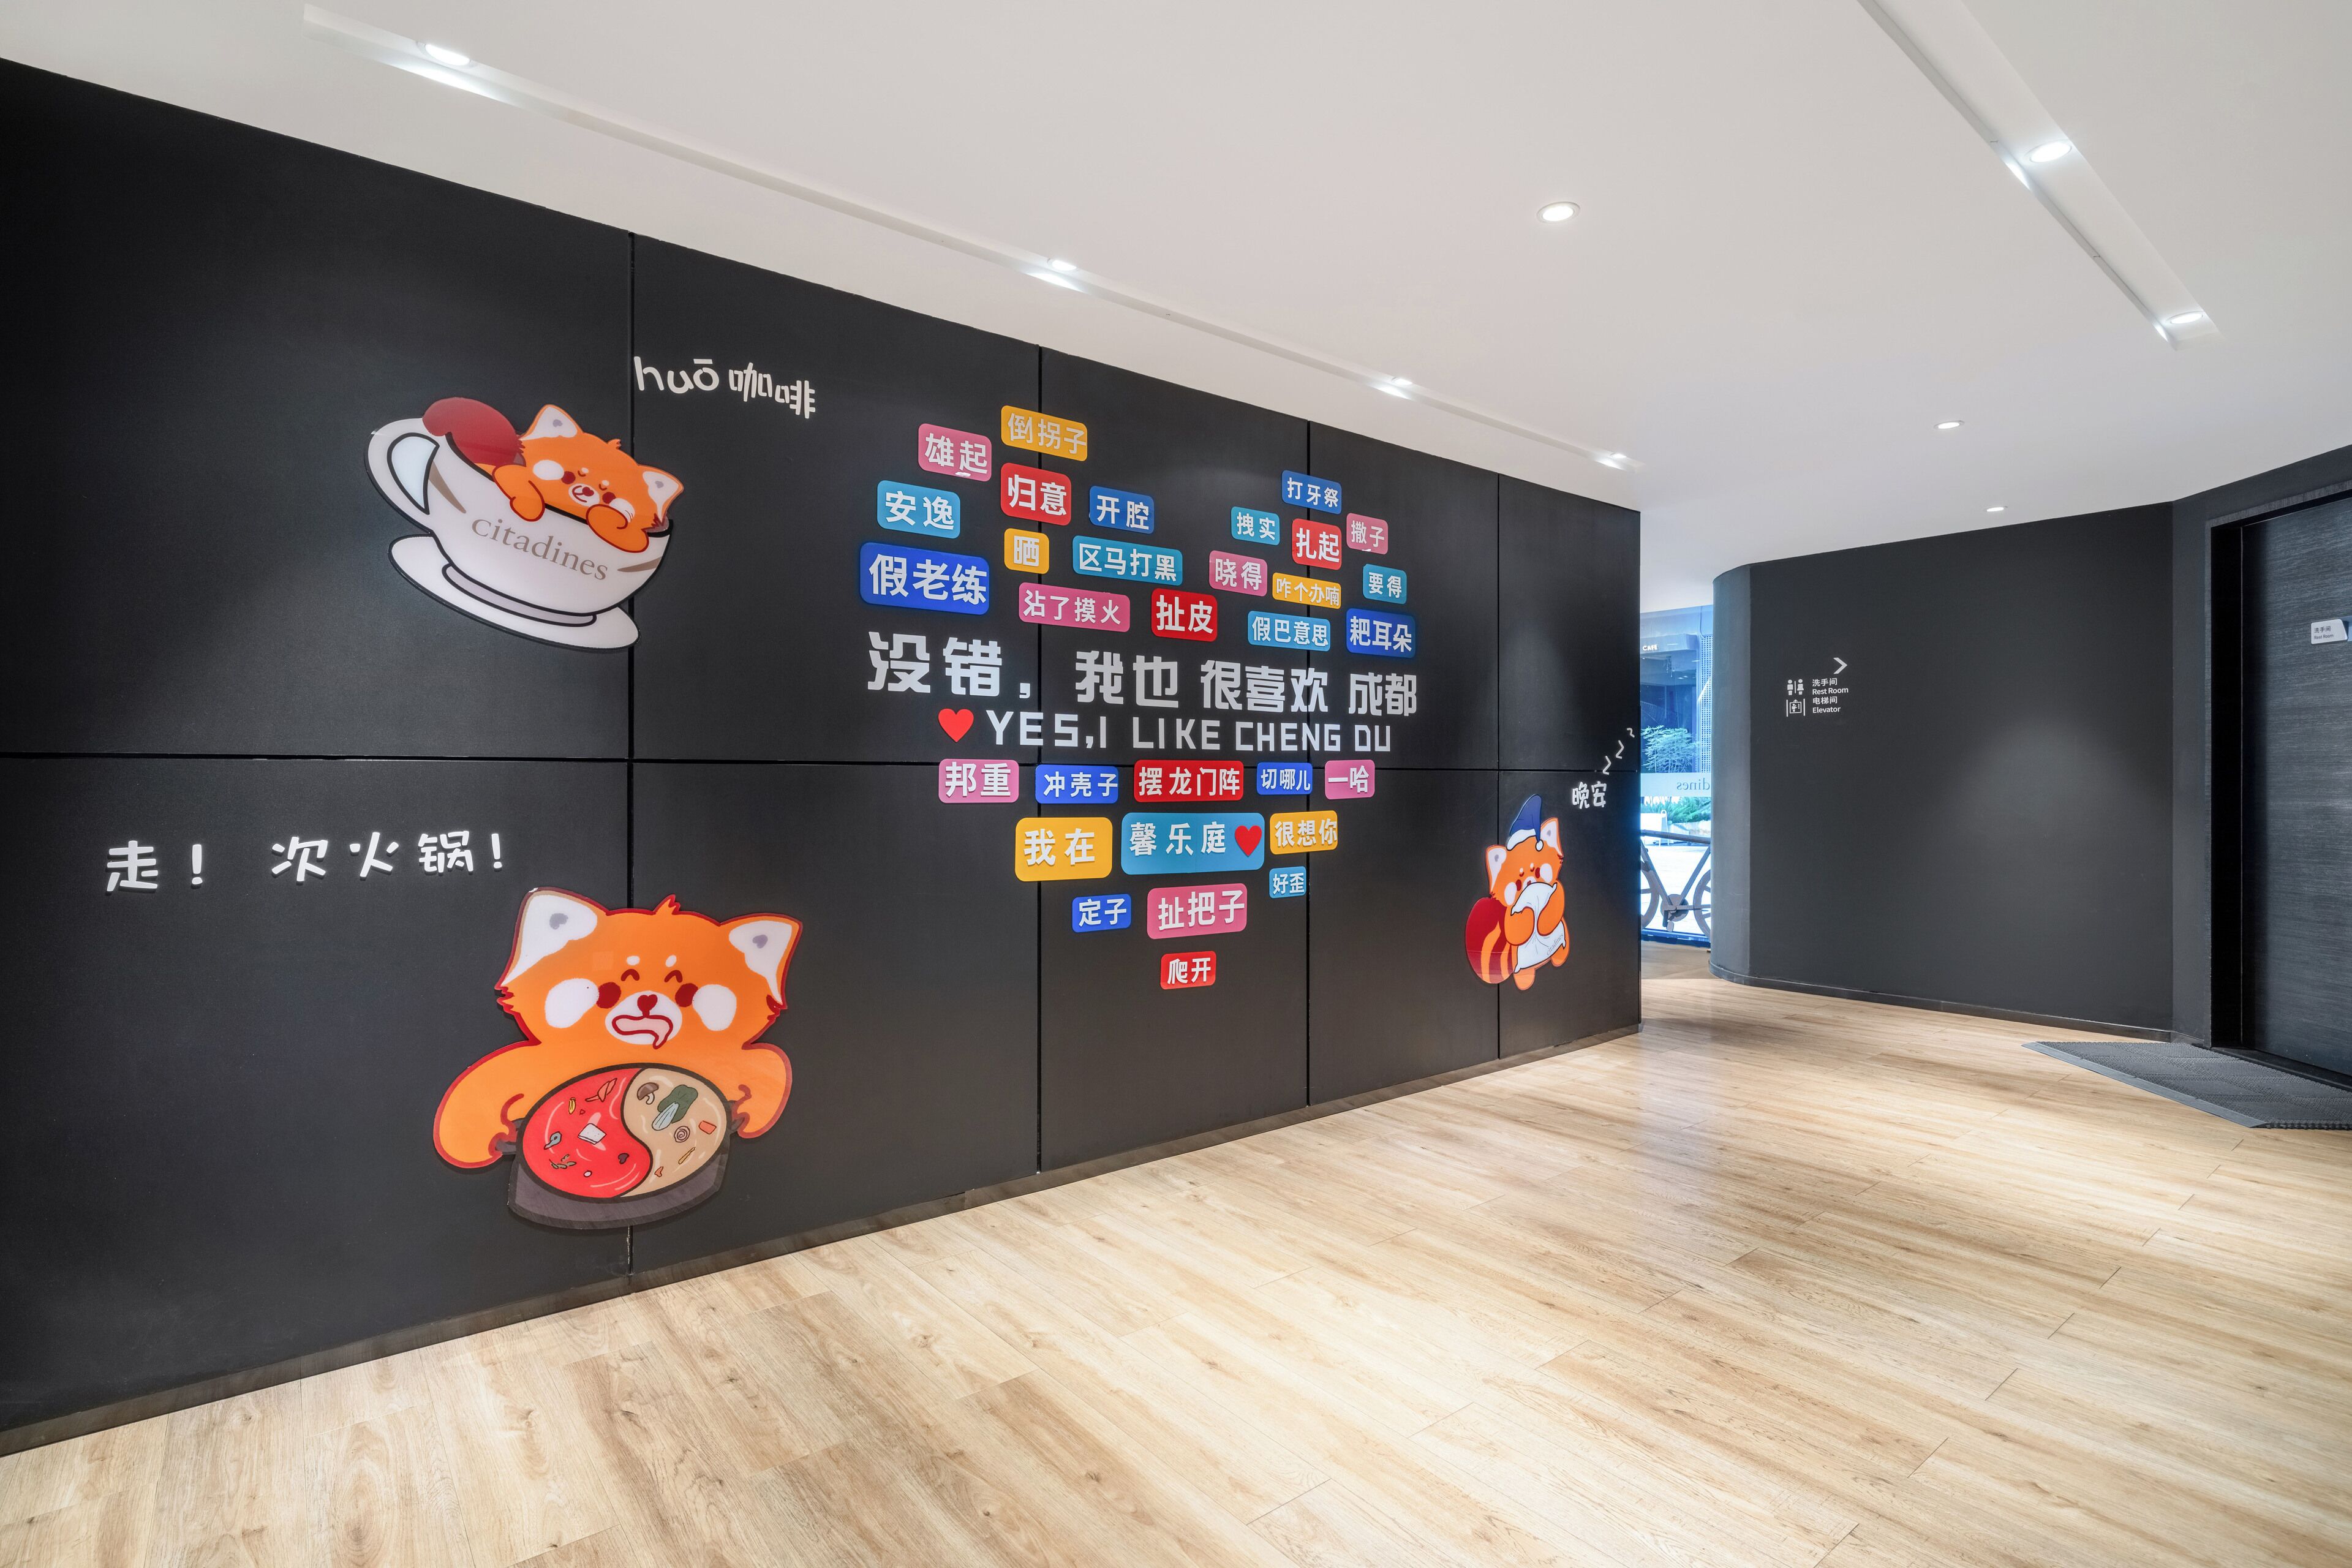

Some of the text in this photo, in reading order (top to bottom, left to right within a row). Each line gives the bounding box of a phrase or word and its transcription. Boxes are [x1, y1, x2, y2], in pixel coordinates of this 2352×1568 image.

[728, 362, 815, 418] 咖啡
[1008, 413, 1087, 454] 倒拐子
[925, 432, 988, 474] 雄起
[1008, 474, 1067, 516] 归意
[1287, 477, 1339, 508] 打牙祭
[885, 491, 954, 530] 安逸
[1096, 495, 1149, 530] 开腔
[1237, 512, 1275, 540] 拽实
[472, 518, 608, 581] citadines
[1296, 528, 1340, 563] 扎起
[1351, 520, 1385, 548] 撒子
[1014, 535, 1039, 567] 晒
[1079, 543, 1177, 582] 区马打黑
[869, 553, 987, 605] 假老练
[1215, 558, 1262, 590] 晓得
[1369, 571, 1402, 598] 要得
[1023, 589, 1121, 625] 沾了摸火
[1276, 578, 1340, 606] 咋个办喃
[1156, 595, 1213, 634] 扯皮
[1252, 616, 1329, 647] 假巴意思
[1349, 616, 1412, 652] 耙耳朵
[1349, 673, 1417, 717] 成都
[1812, 678, 1838, 687] 洗手间
[1812, 696, 1838, 705] 电梯间
[1133, 717, 1220, 750] LIKE
[1235, 721, 1341, 752] CHENG
[1354, 725, 1391, 753] DU
[945, 762, 1011, 797] 邦重
[1043, 771, 1118, 797] 冲壳子
[1139, 767, 1240, 796] 摆龙门阵
[1261, 768, 1311, 791] 切哪儿
[1328, 766, 1370, 793] 一哈
[1572, 780, 1607, 810] 晚安
[1023, 827, 1096, 865] 我在
[1129, 821, 1226, 856] 馨乐庭
[1275, 818, 1338, 847] 很想你
[1273, 872, 1305, 895] 好歪
[1079, 898, 1128, 927] 定子
[1158, 889, 1245, 931] 扯把子
[1167, 957, 1211, 985] 爬开
